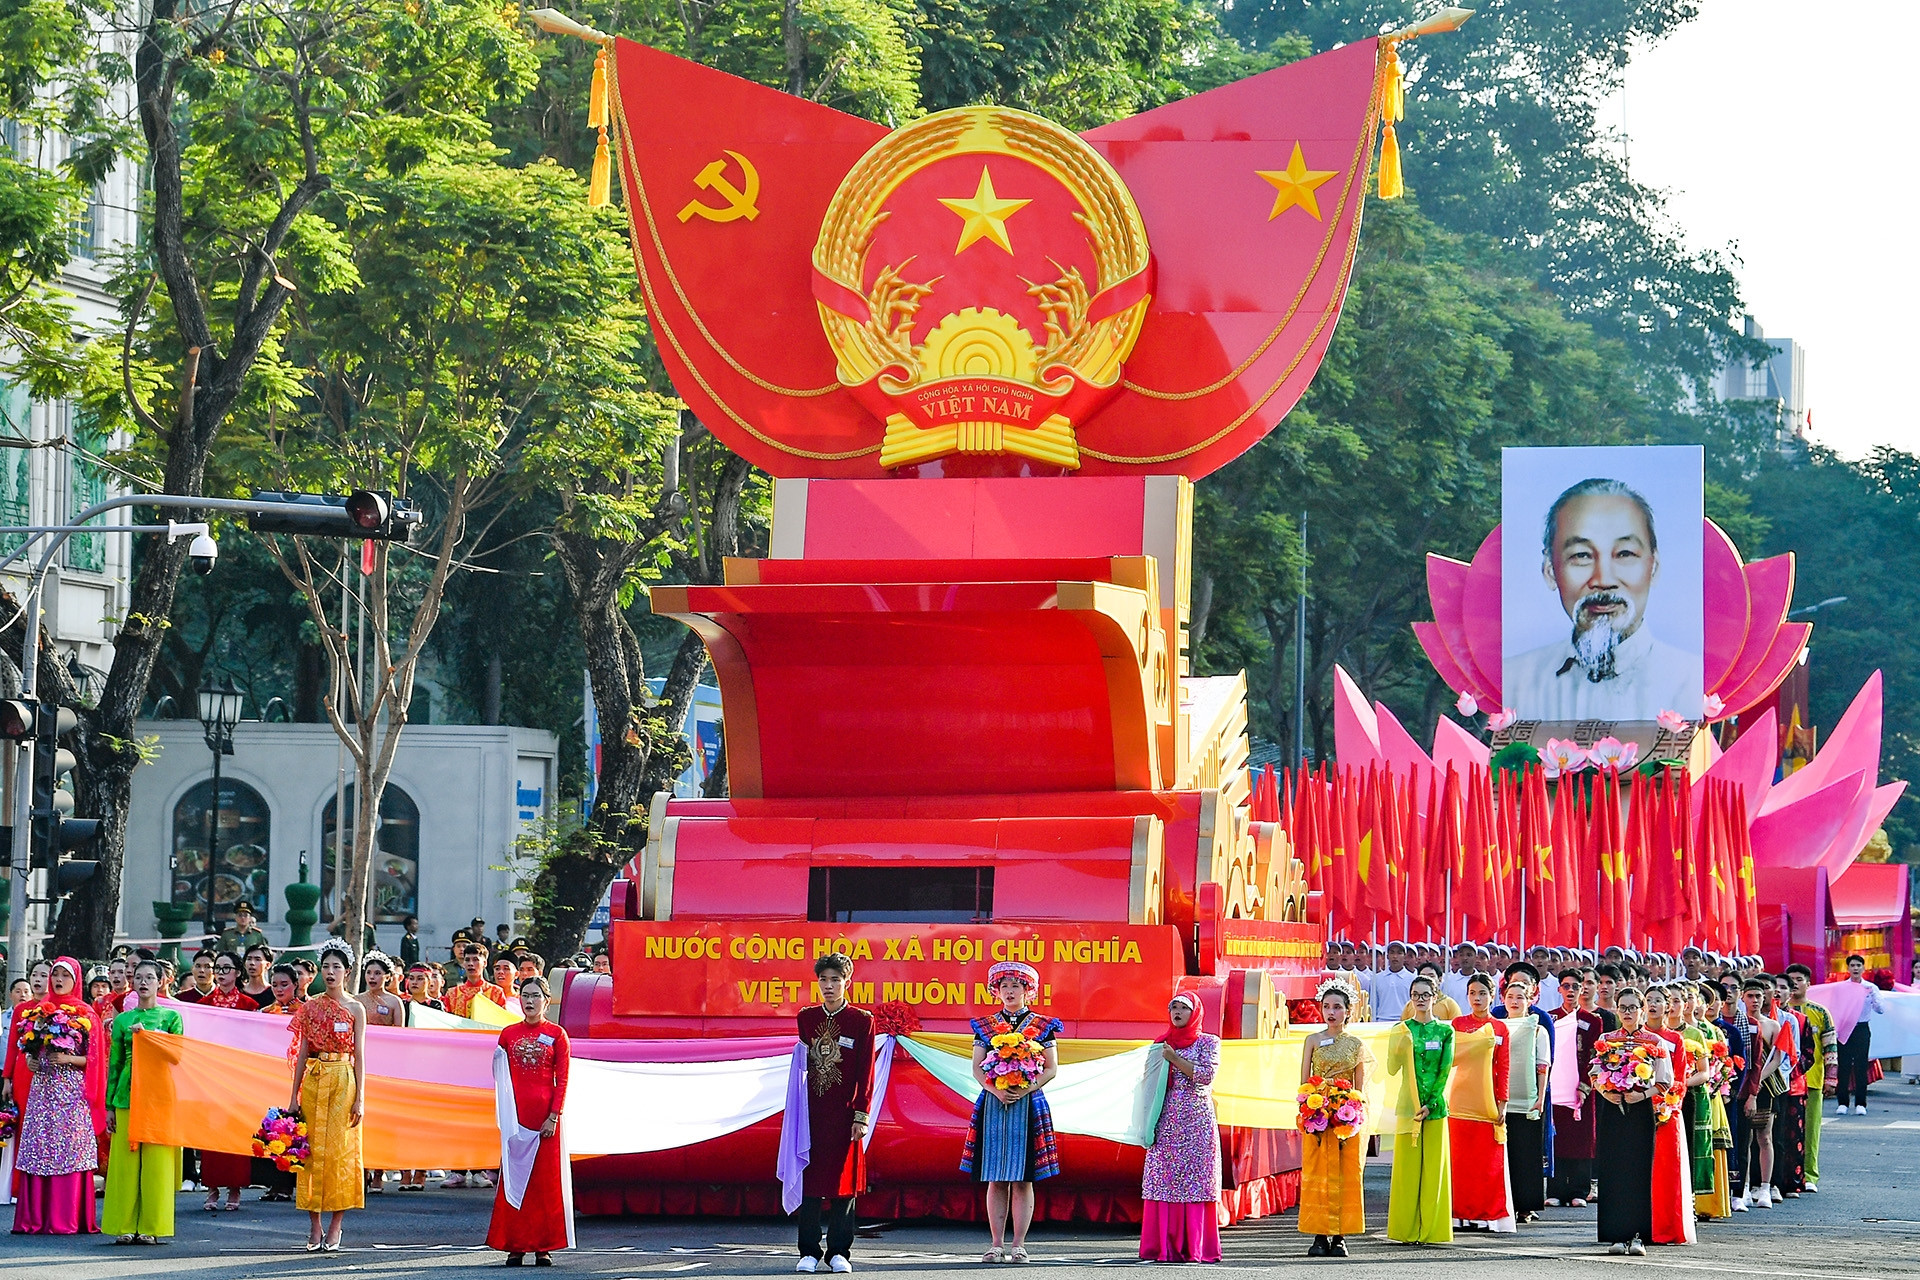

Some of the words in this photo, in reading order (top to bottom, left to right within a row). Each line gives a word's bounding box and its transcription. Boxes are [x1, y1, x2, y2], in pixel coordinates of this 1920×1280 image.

[917, 389, 941, 401] CỘNG
[942, 385, 959, 395] HÒA
[976, 383, 990, 393] HỘI
[992, 384, 1009, 395] CHỦ
[1011, 389, 1034, 401] NGHĨA
[921, 395, 975, 419] VIỆT
[982, 396, 1032, 421] NAM
[645, 930, 722, 960] NƯỚC
[729, 932, 805, 963] CỘNG
[812, 932, 873, 961] HÒA
[882, 934, 925, 961] XÃ
[932, 934, 983, 965] HỘI
[991, 933, 1045, 963] CHỦ
[1053, 937, 1142, 963] NGHĨA
[738, 977, 802, 1008] VIỆT
[810, 981, 875, 1004] NM
[882, 977, 965, 1005] MUÔN
